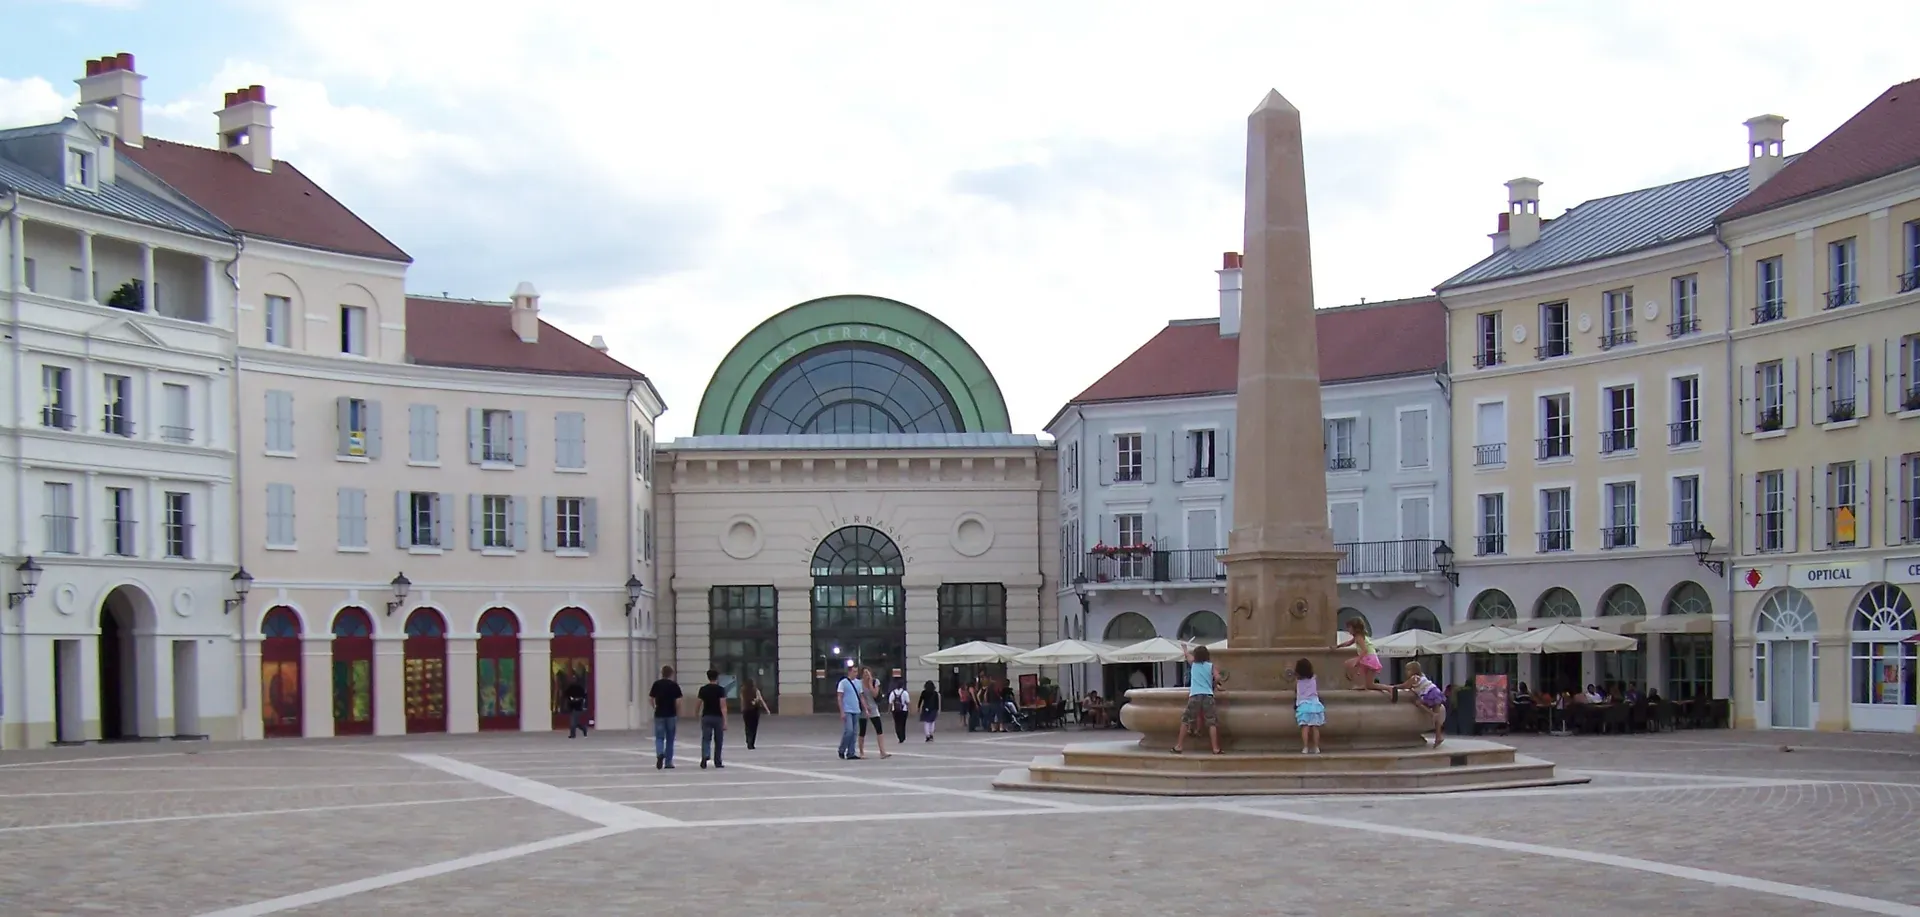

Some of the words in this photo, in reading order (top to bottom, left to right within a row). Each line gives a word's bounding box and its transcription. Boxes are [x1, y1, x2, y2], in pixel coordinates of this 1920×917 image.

[762, 344, 796, 372] LES
[801, 535, 819, 563] LES
[831, 515, 914, 563] TERRASSES
[1808, 569, 1852, 581] OPTICAL
